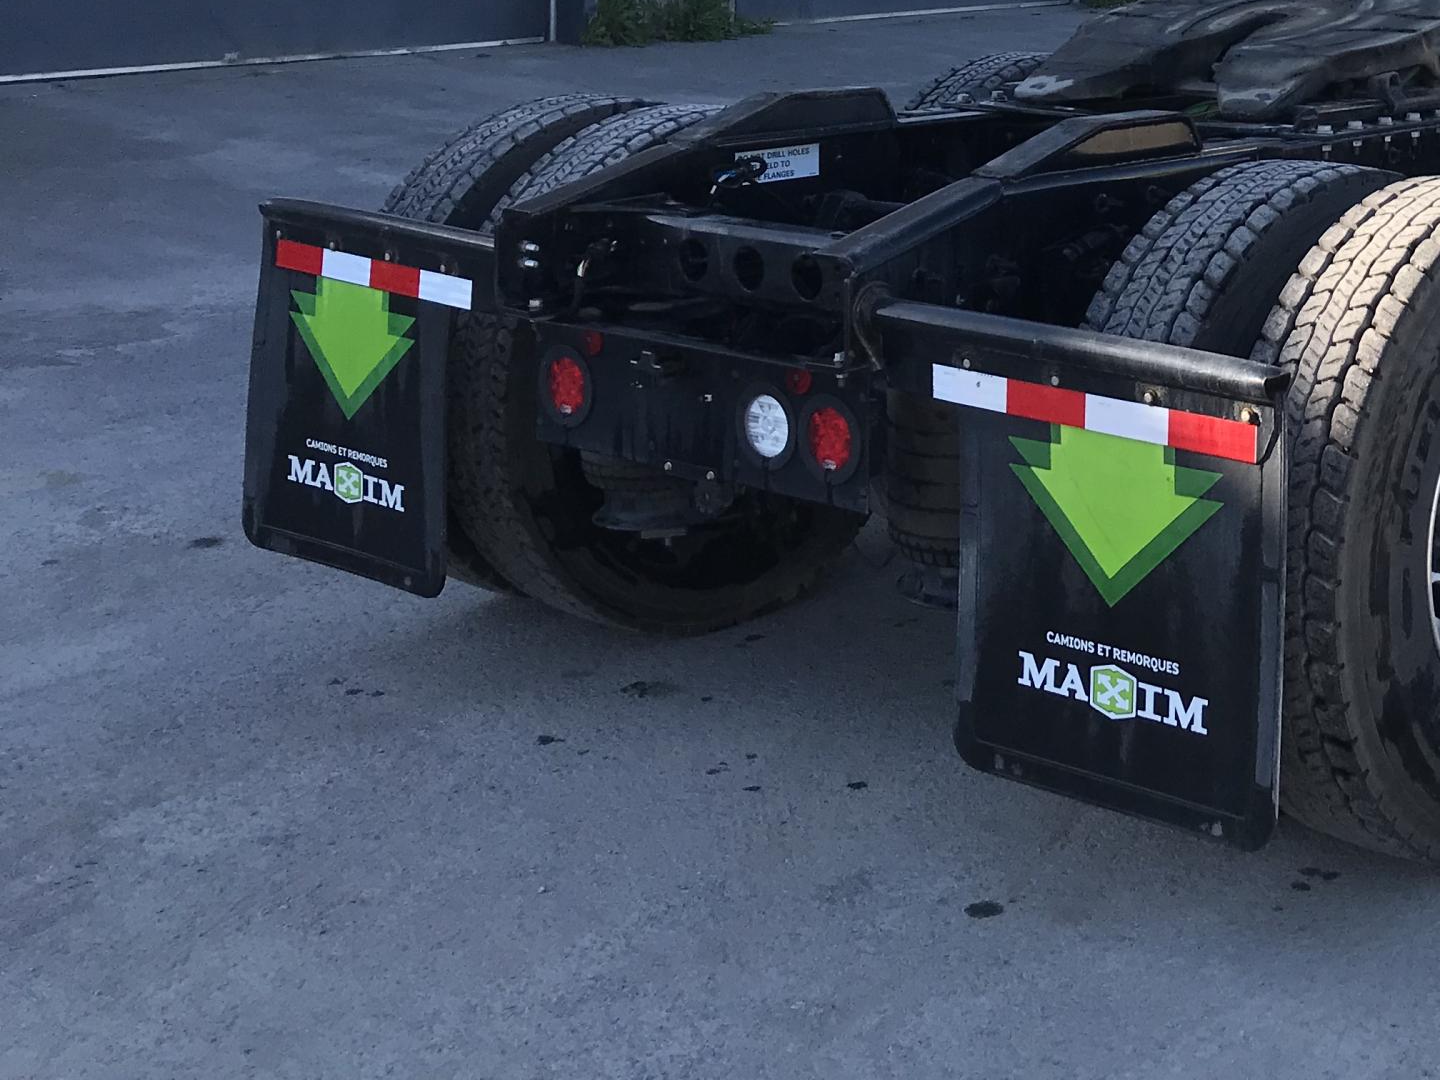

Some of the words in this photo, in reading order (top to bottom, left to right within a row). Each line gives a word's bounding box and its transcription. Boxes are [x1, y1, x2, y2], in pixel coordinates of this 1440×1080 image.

[767, 151, 785, 159] DRILL
[787, 148, 810, 156] HOLES
[781, 160, 790, 168] TO
[764, 170, 795, 180] FLANGES
[306, 438, 337, 455] CAMIONS
[338, 446, 347, 456] ET
[347, 449, 388, 469] REMORQUES
[287, 454, 405, 513] MAXIM
[1046, 631, 1095, 654] CAMIONS
[1097, 643, 1112, 658] ET
[1112, 646, 1180, 676] REMORQUES
[1017, 650, 1209, 736] MAXIM
